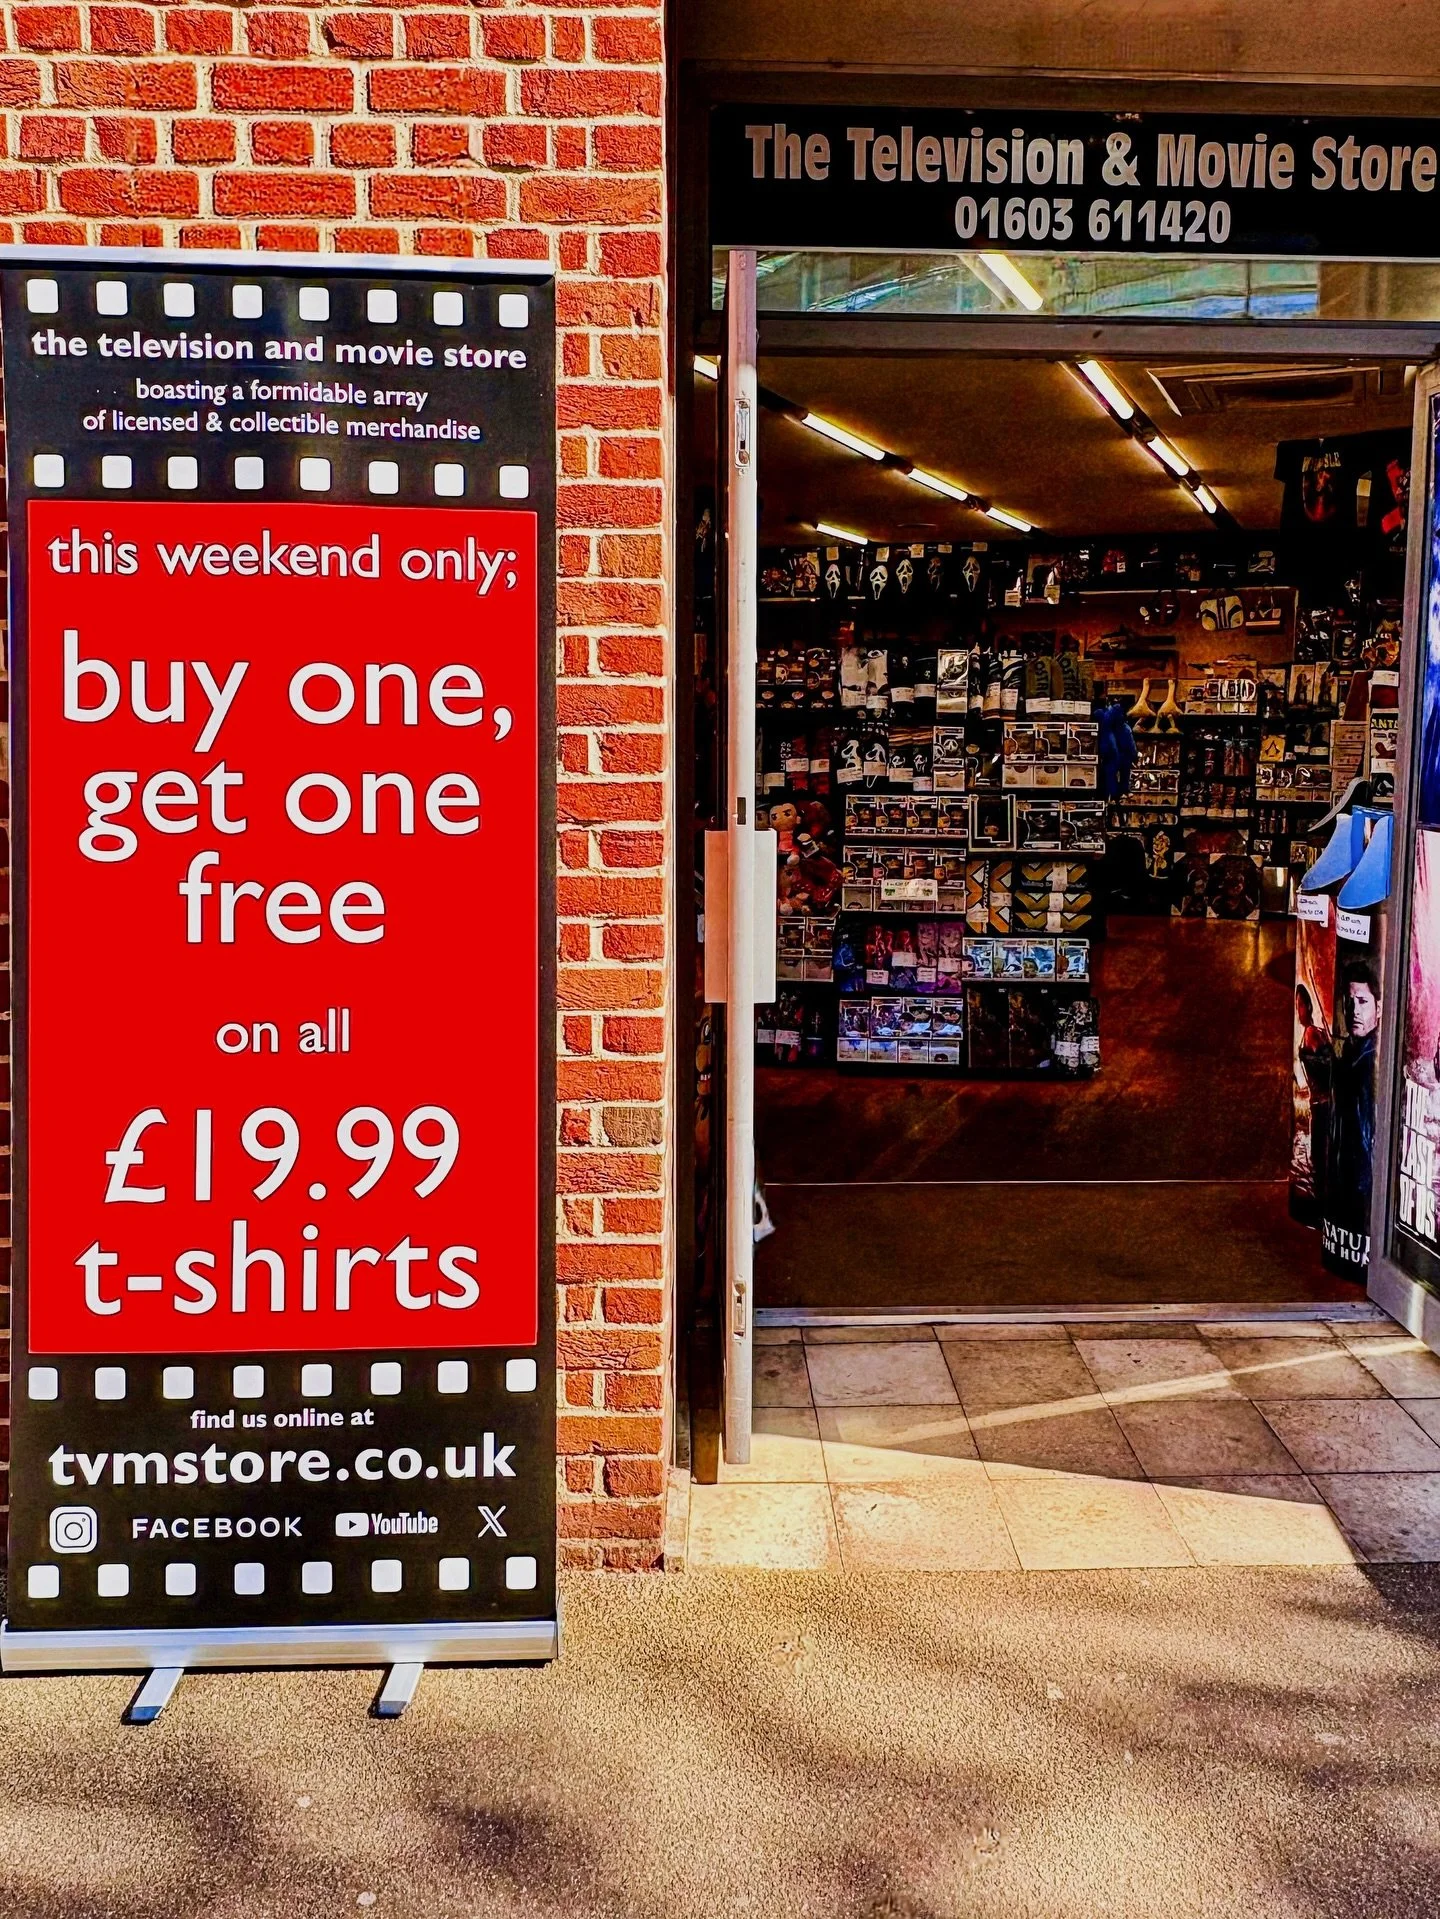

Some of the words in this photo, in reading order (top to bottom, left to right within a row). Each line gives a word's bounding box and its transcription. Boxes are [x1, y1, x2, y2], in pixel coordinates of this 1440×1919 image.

[745, 123, 831, 180] The
[847, 126, 1084, 185] Television
[1102, 132, 1140, 186] &
[1157, 133, 1295, 189] Movie
[1311, 135, 1437, 192] Store
[955, 196, 1073, 241] 01603
[1089, 199, 1231, 244] 611420
[32, 329, 87, 357] the
[98, 331, 253, 360] television
[265, 336, 323, 362] and
[336, 338, 434, 366] movie
[444, 341, 527, 369] store
[83, 410, 106, 430] of
[112, 410, 198, 433] licensed
[206, 413, 223, 432] &
[230, 413, 339, 435] collectible
[346, 418, 480, 440] merchandise
[136, 378, 227, 405] boasting
[232, 385, 244, 400] a
[250, 380, 367, 405] formidable
[373, 389, 428, 410] array
[48, 529, 138, 575] this
[157, 530, 380, 577] weekend
[401, 538, 518, 595] only;
[63, 630, 249, 752] buy
[288, 661, 514, 741] one,
[78, 761, 247, 862] get
[285, 771, 480, 835] one
[179, 851, 386, 944] free
[216, 1021, 278, 1054] on
[299, 1007, 351, 1053] all
[104, 1105, 460, 1204] £19.99
[1401, 1124, 1435, 1190] LAST
[1400, 1174, 1414, 1226] OF
[1416, 1183, 1437, 1242] US
[75, 1219, 480, 1315] t-shirts
[190, 1409, 235, 1429] find
[242, 1412, 267, 1428] us
[273, 1408, 344, 1427] online
[350, 1409, 374, 1426] at
[48, 1432, 517, 1485] tvmstore.co.uk
[132, 1516, 302, 1539] FACEBOOK
[371, 1511, 439, 1535] YouTube
